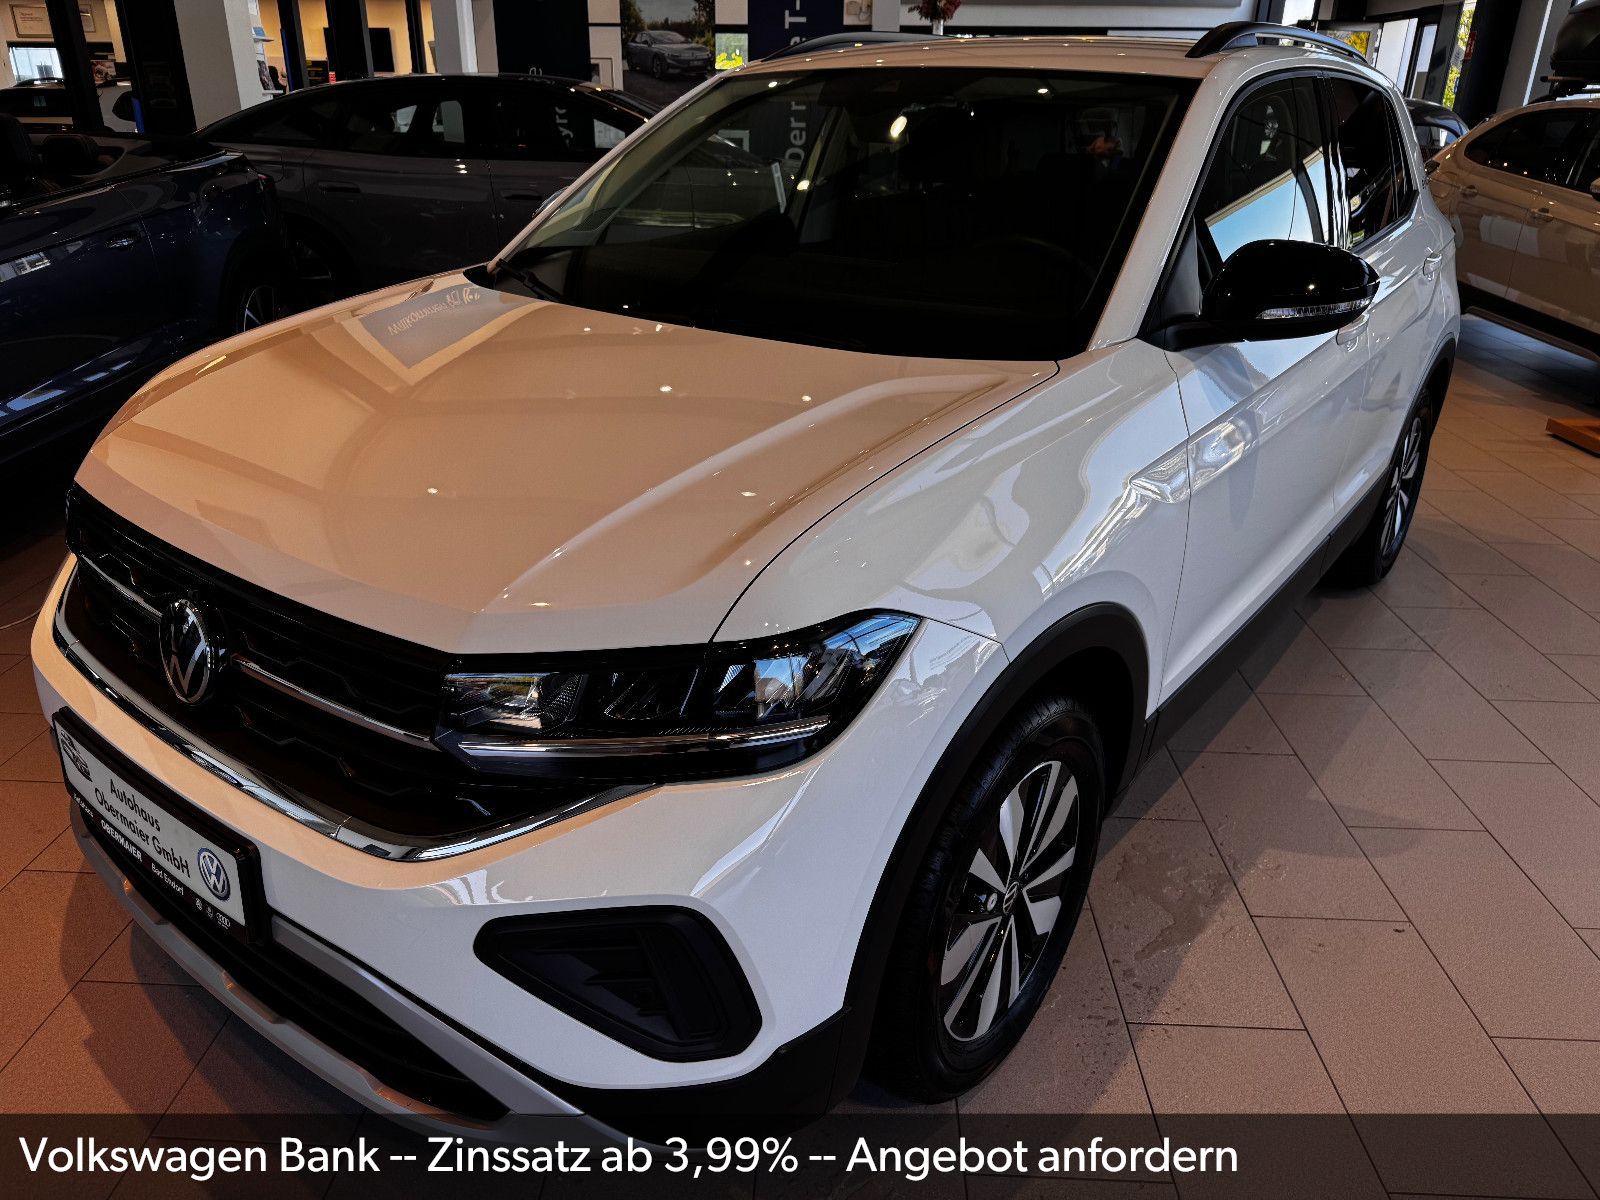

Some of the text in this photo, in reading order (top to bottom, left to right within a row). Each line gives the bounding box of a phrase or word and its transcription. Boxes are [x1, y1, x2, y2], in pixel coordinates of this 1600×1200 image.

[110, 778, 161, 832] Autohaus
[95, 787, 150, 846] Obermaier
[152, 835, 191, 879] GmbH
[100, 819, 143, 863] OBERMAIER
